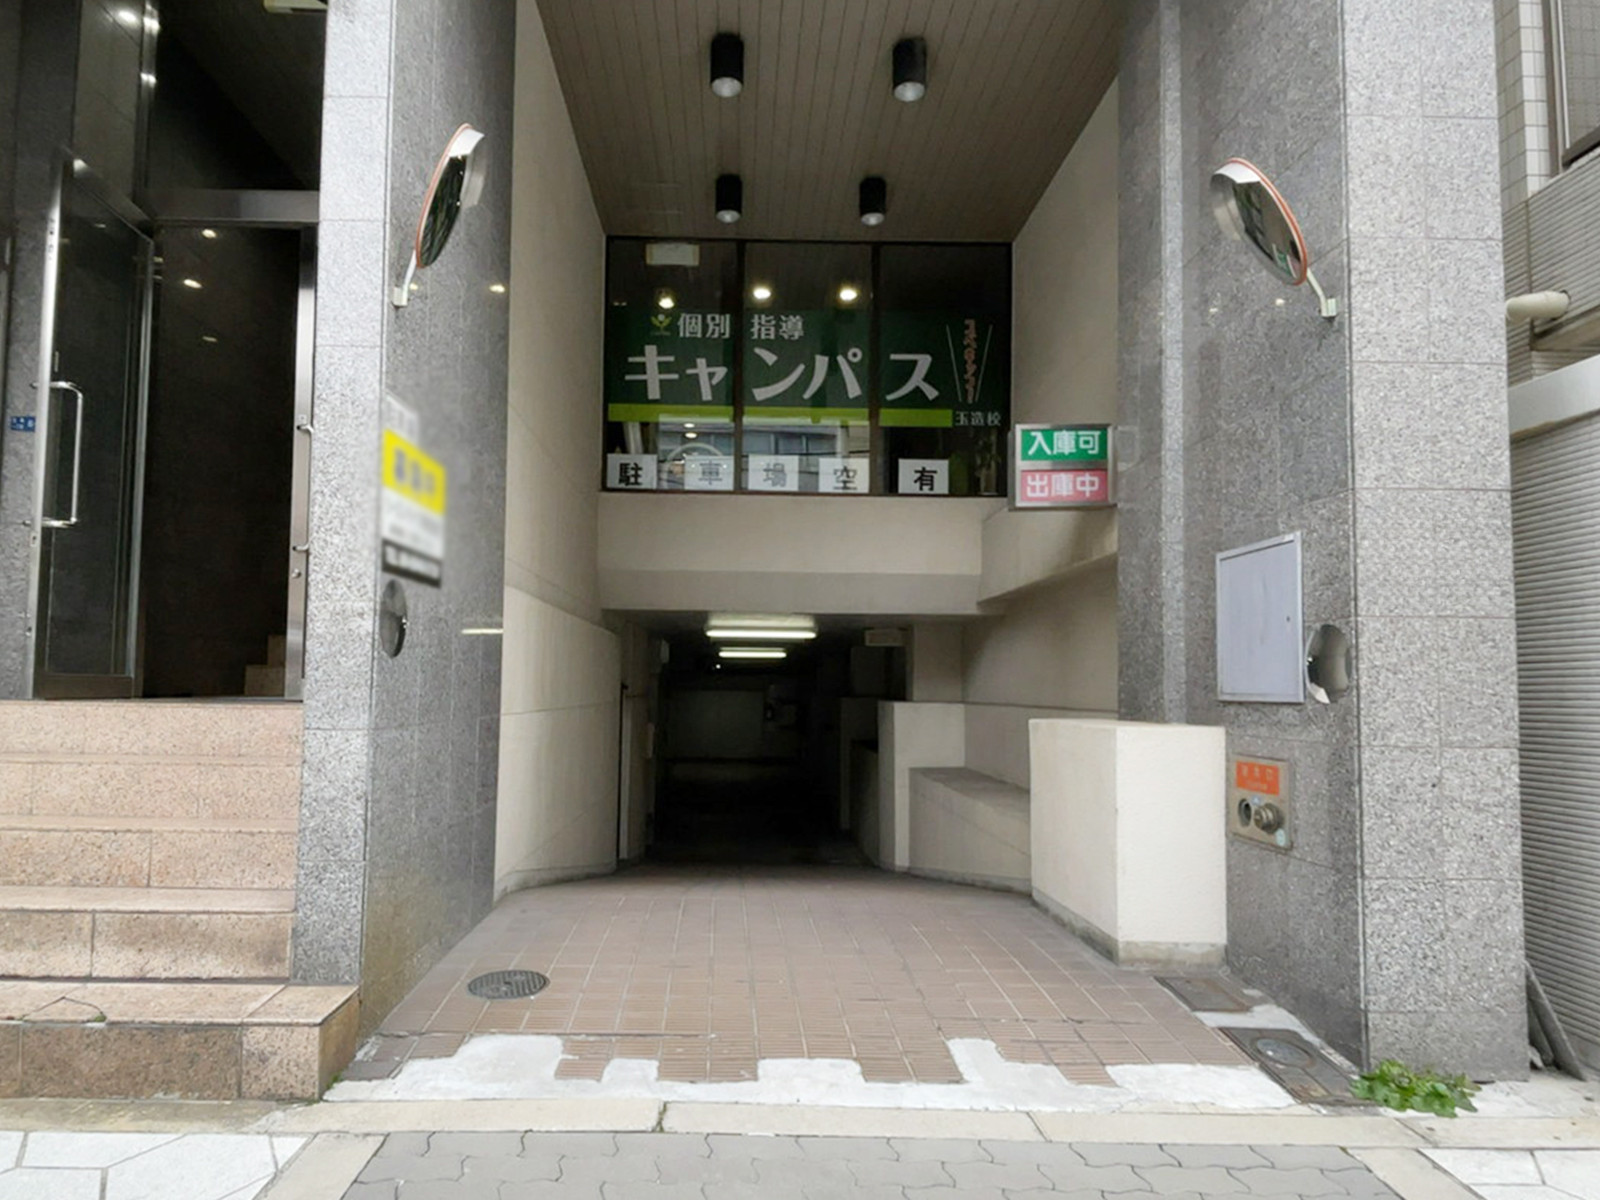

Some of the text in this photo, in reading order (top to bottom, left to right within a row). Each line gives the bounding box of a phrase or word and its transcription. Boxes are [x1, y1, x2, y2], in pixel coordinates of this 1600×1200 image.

[624, 345, 940, 402] キャンパス
[1028, 429, 1101, 455] 入庫可
[1026, 472, 1099, 497] 出庫中
